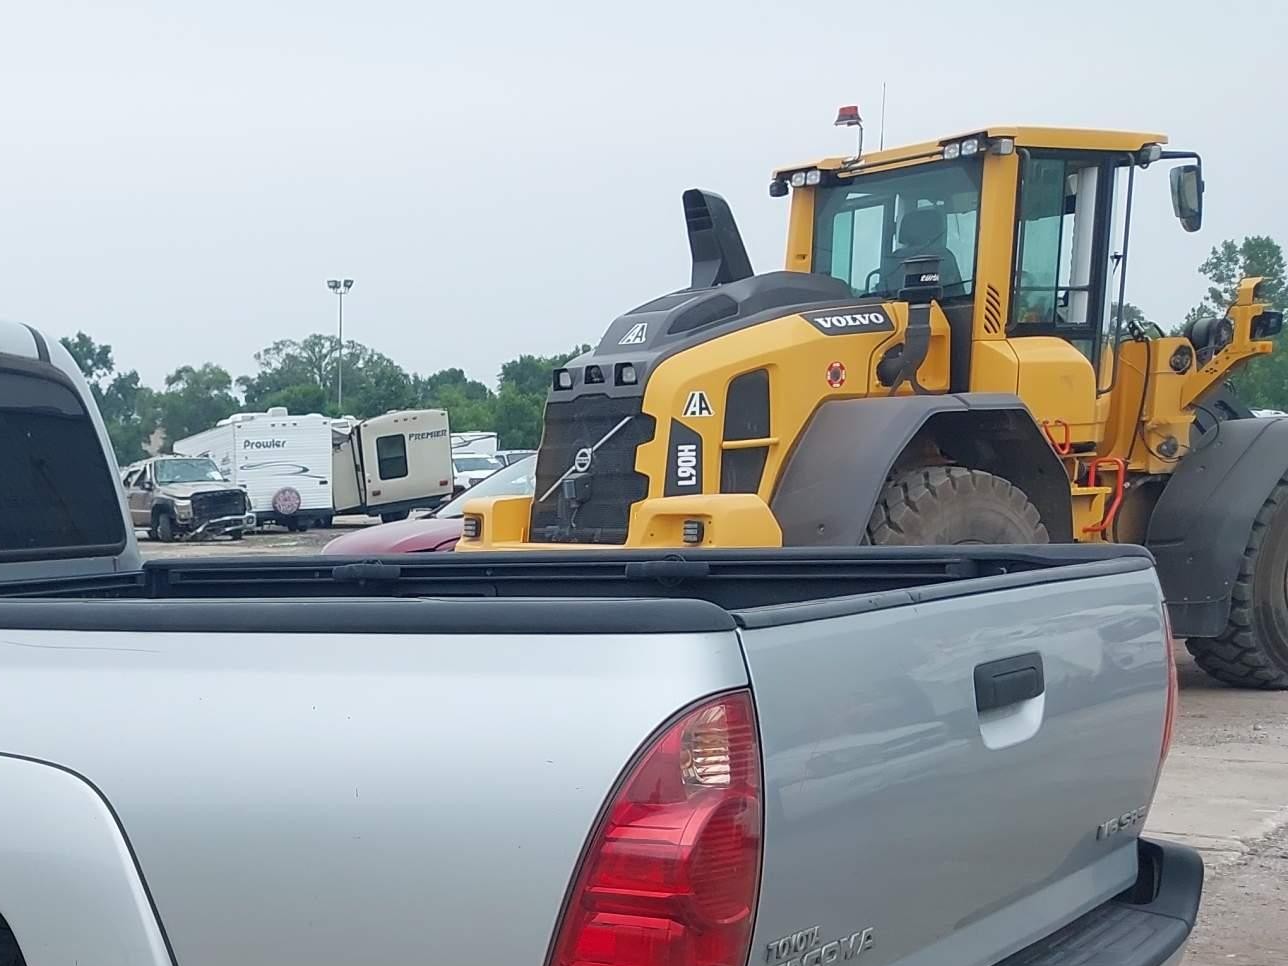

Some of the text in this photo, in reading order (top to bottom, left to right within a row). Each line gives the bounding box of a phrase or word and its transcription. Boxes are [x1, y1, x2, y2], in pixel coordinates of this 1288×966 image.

[814, 312, 885, 328] VOLVO
[408, 429, 447, 441] PREMIER
[243, 439, 287, 449] Prowler
[677, 444, 697, 486] L90H
